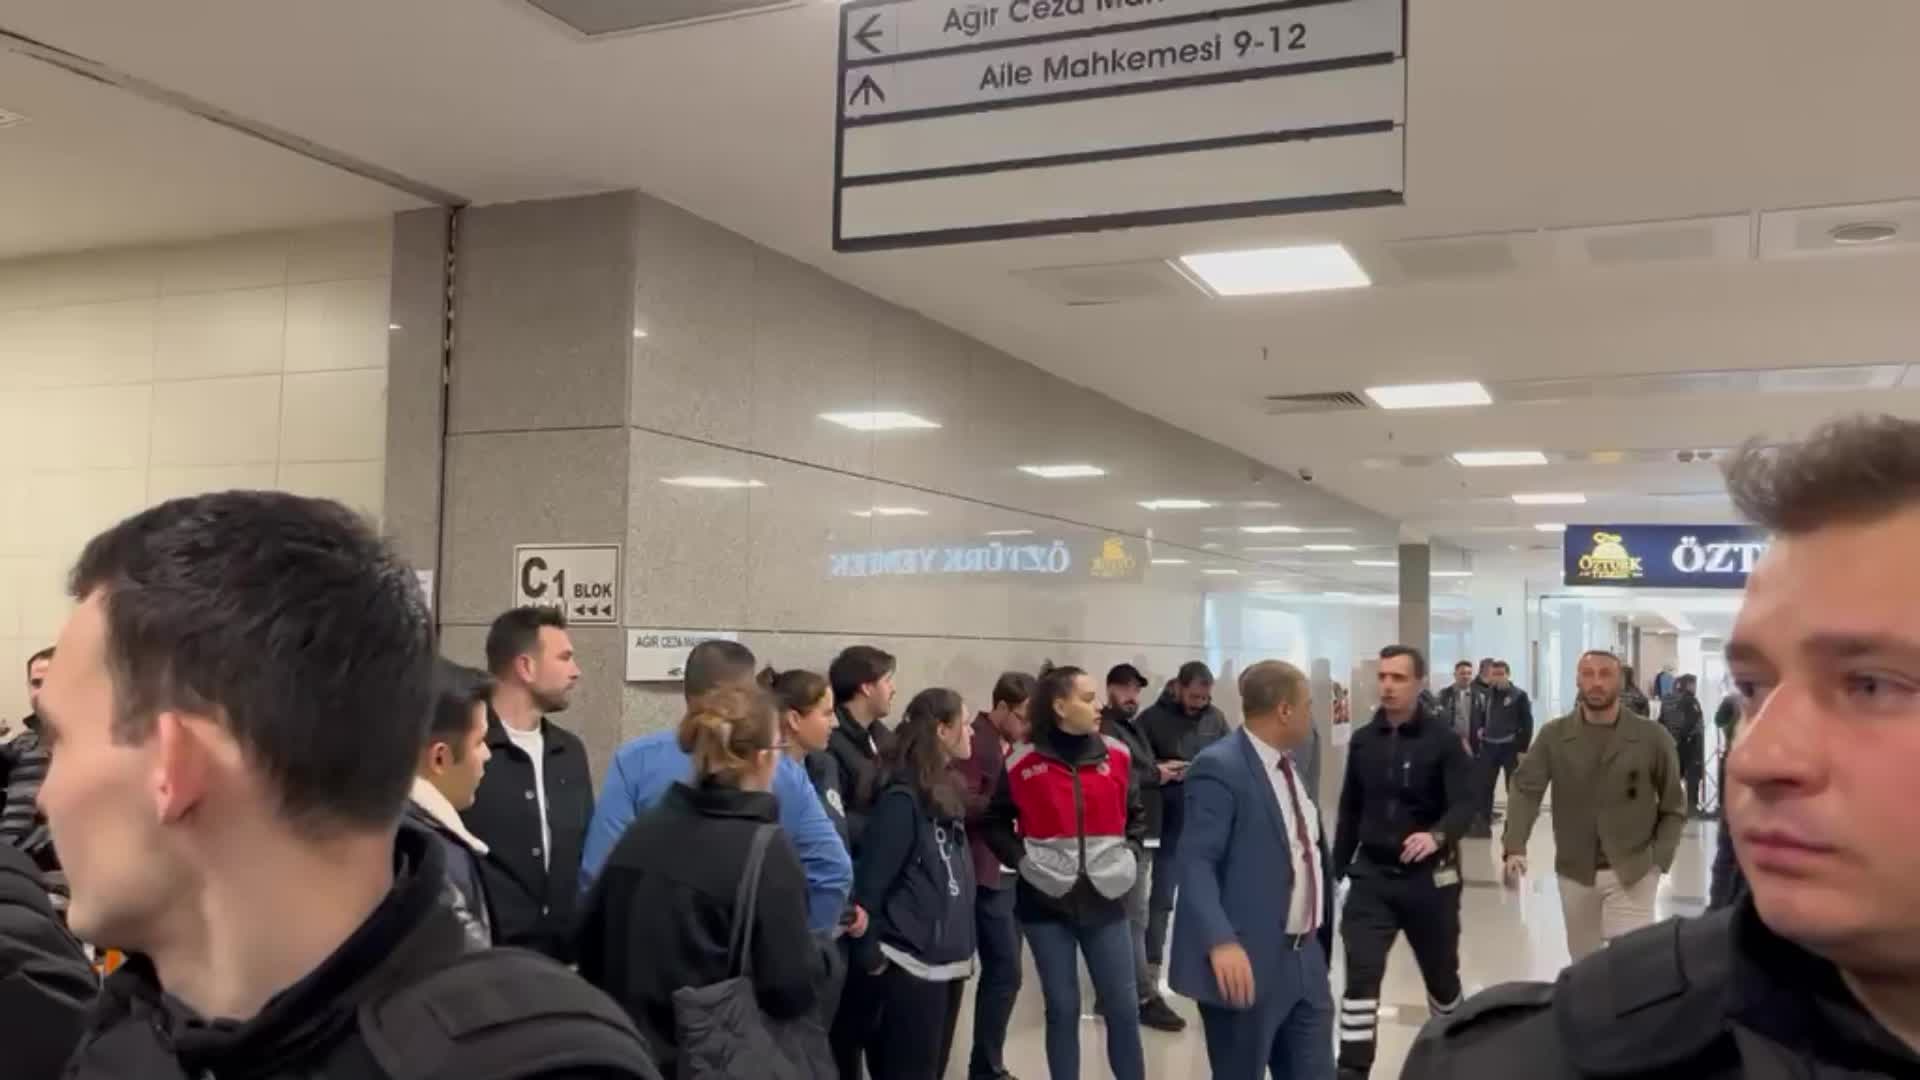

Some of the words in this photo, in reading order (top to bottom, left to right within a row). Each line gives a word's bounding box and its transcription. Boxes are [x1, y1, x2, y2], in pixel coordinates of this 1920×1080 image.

[1008, 0, 1085, 23] Ceza
[978, 63, 1033, 90] Aile
[1043, 34, 1222, 83] Mahkemesi
[1233, 23, 1307, 56] 9-12
[573, 583, 612, 599] BLOK
